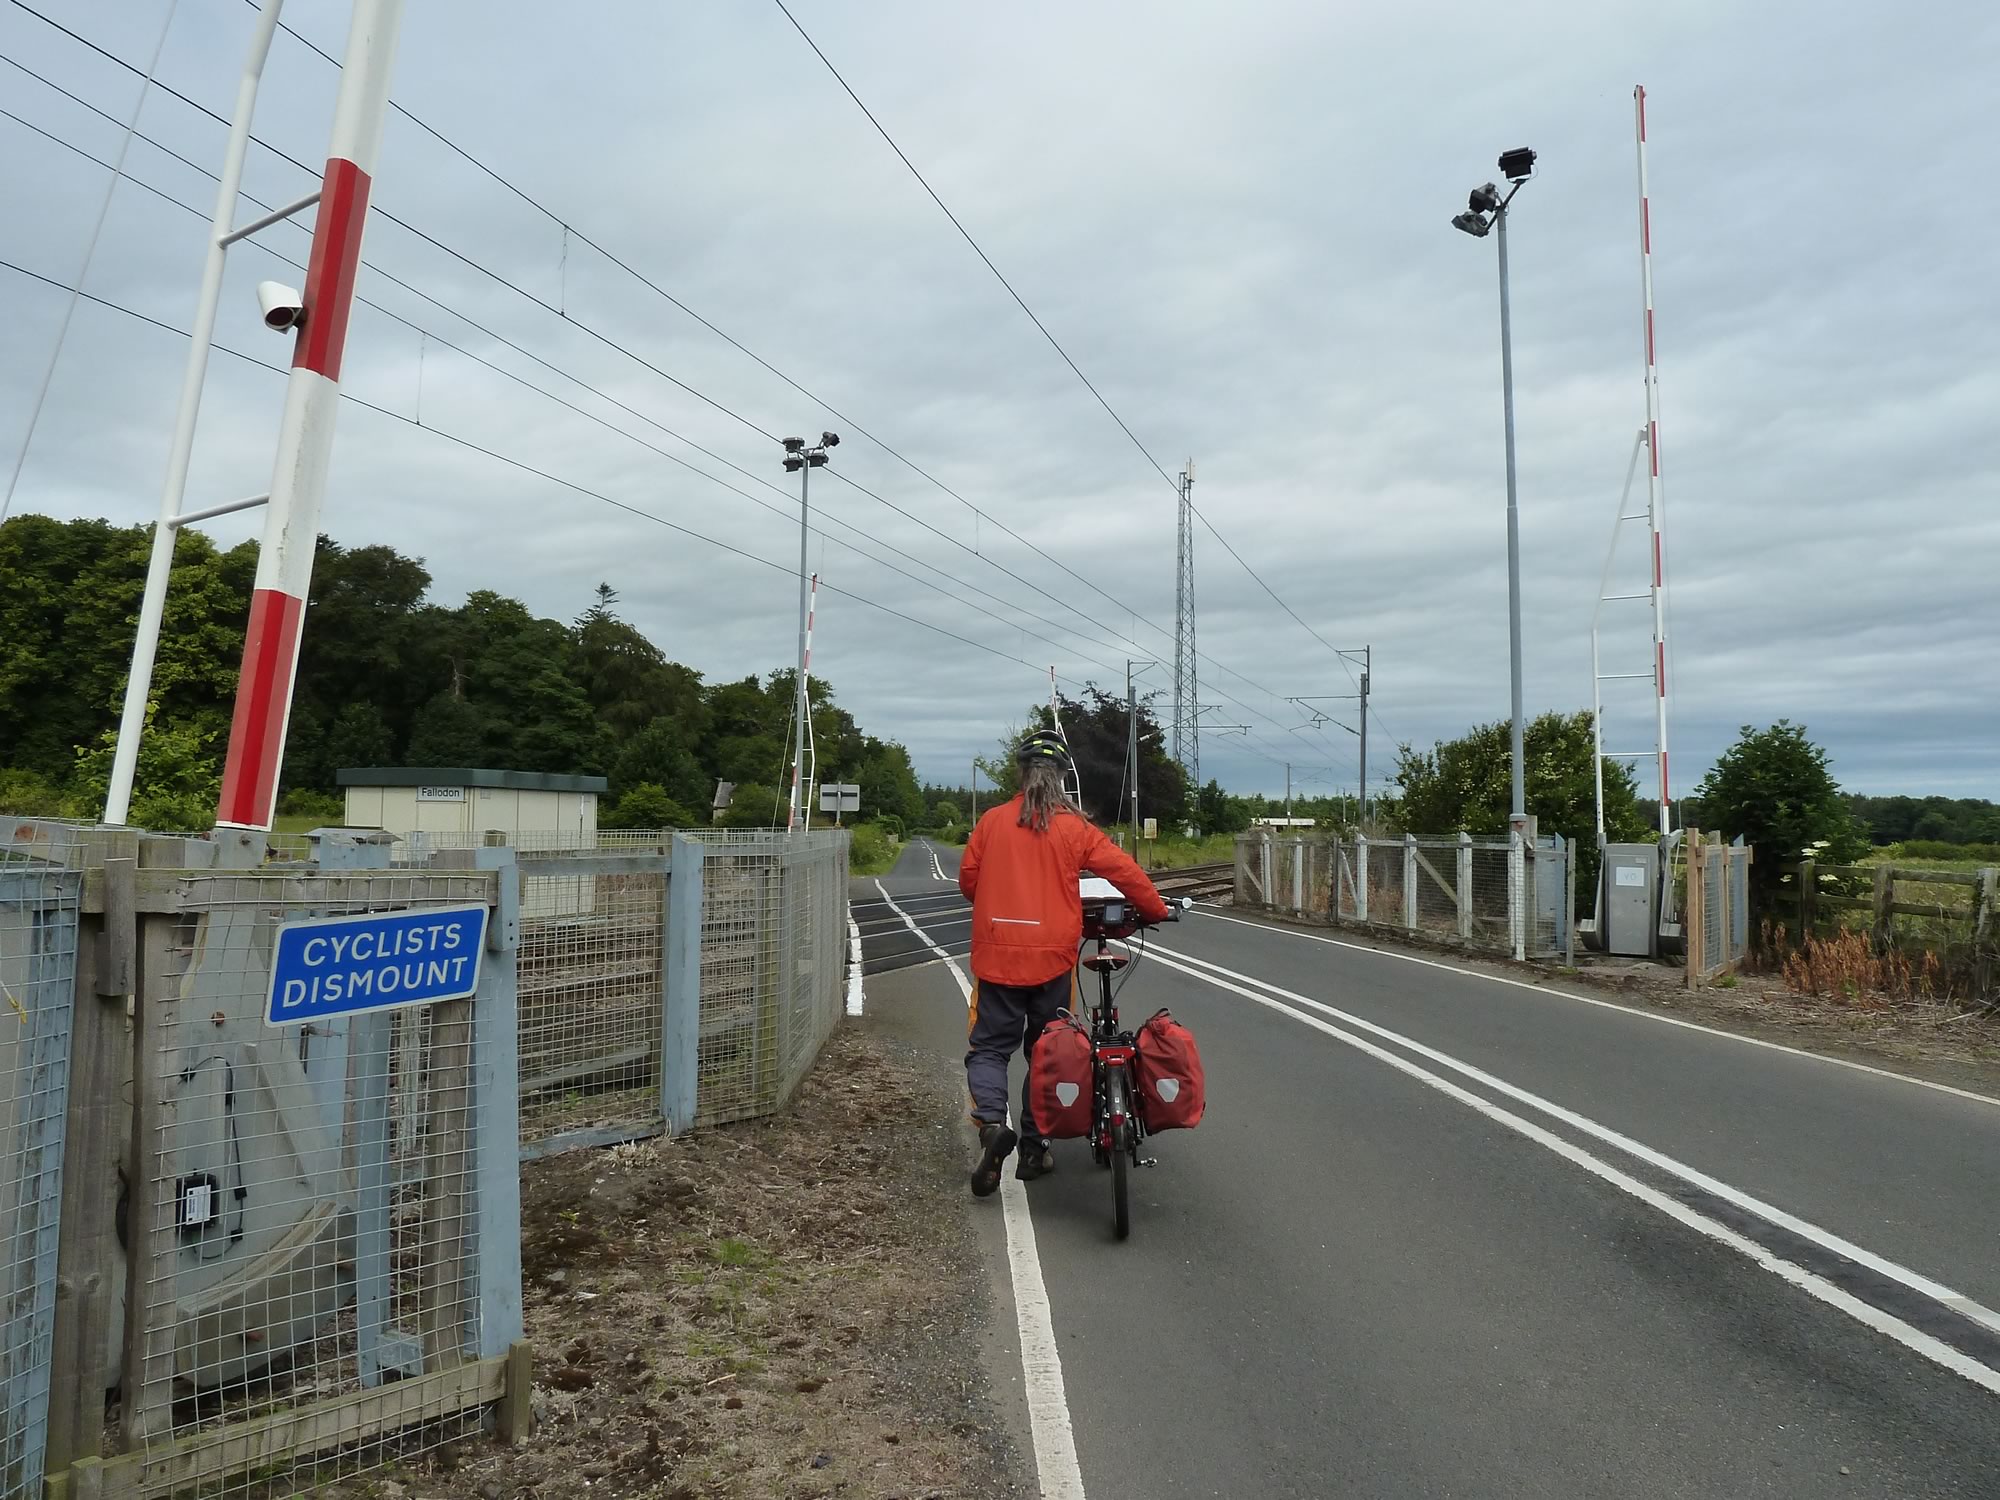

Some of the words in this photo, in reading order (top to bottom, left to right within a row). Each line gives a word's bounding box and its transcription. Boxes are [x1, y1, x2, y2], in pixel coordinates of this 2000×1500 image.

[421, 787, 460, 797] Fallodon
[303, 923, 462, 967] CYCLISTS
[282, 956, 468, 1008] DISMOUNT
